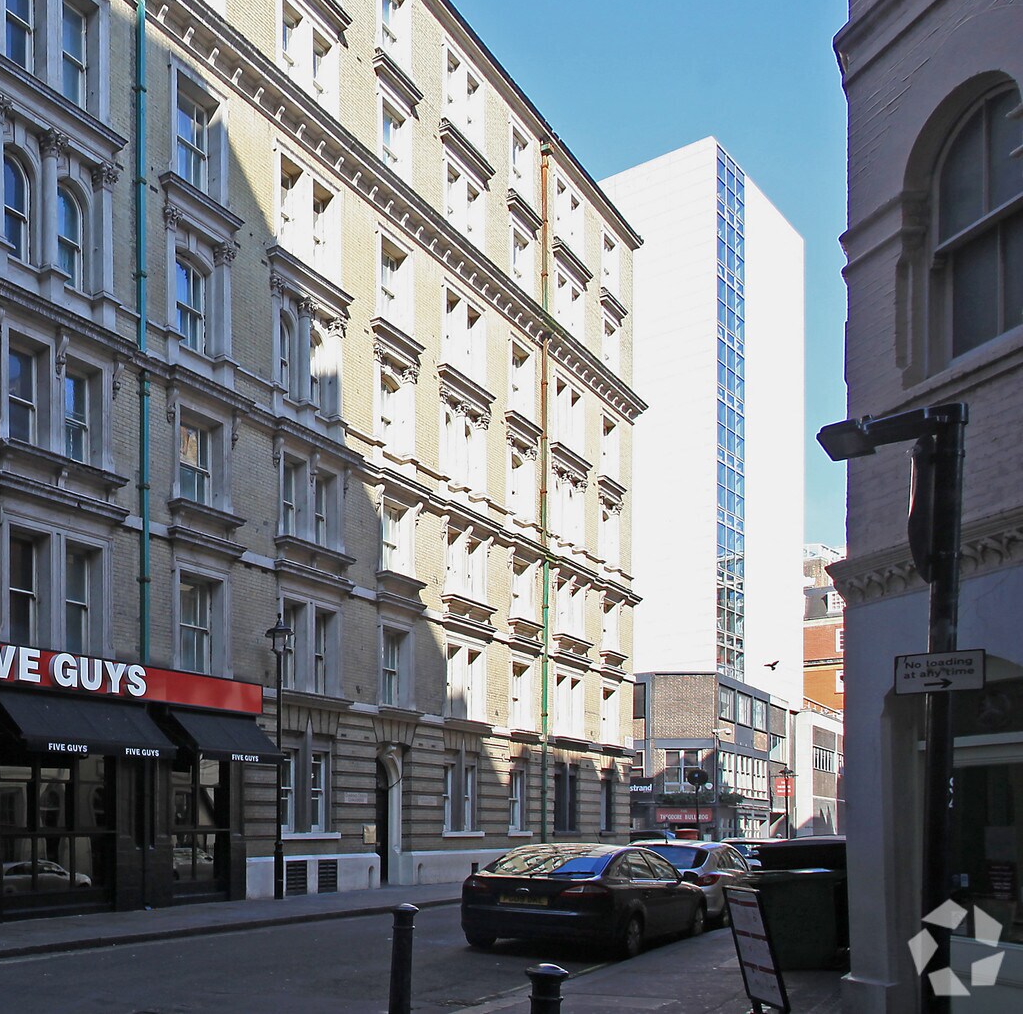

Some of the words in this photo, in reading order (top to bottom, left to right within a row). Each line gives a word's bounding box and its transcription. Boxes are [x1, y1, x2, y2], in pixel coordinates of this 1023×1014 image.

[905, 661, 921, 669] No
[926, 657, 973, 668] loading
[50, 652, 147, 697] GUYS
[903, 671, 916, 679] at
[946, 667, 975, 676] time
[48, 742, 66, 752] FIVE
[66, 743, 88, 753] GUYS
[125, 748, 141, 756] FIVE
[141, 748, 160, 757] GUYS
[231, 753, 244, 762] FIVE
[244, 754, 259, 763] GUYS
[629, 783, 653, 792] strand
